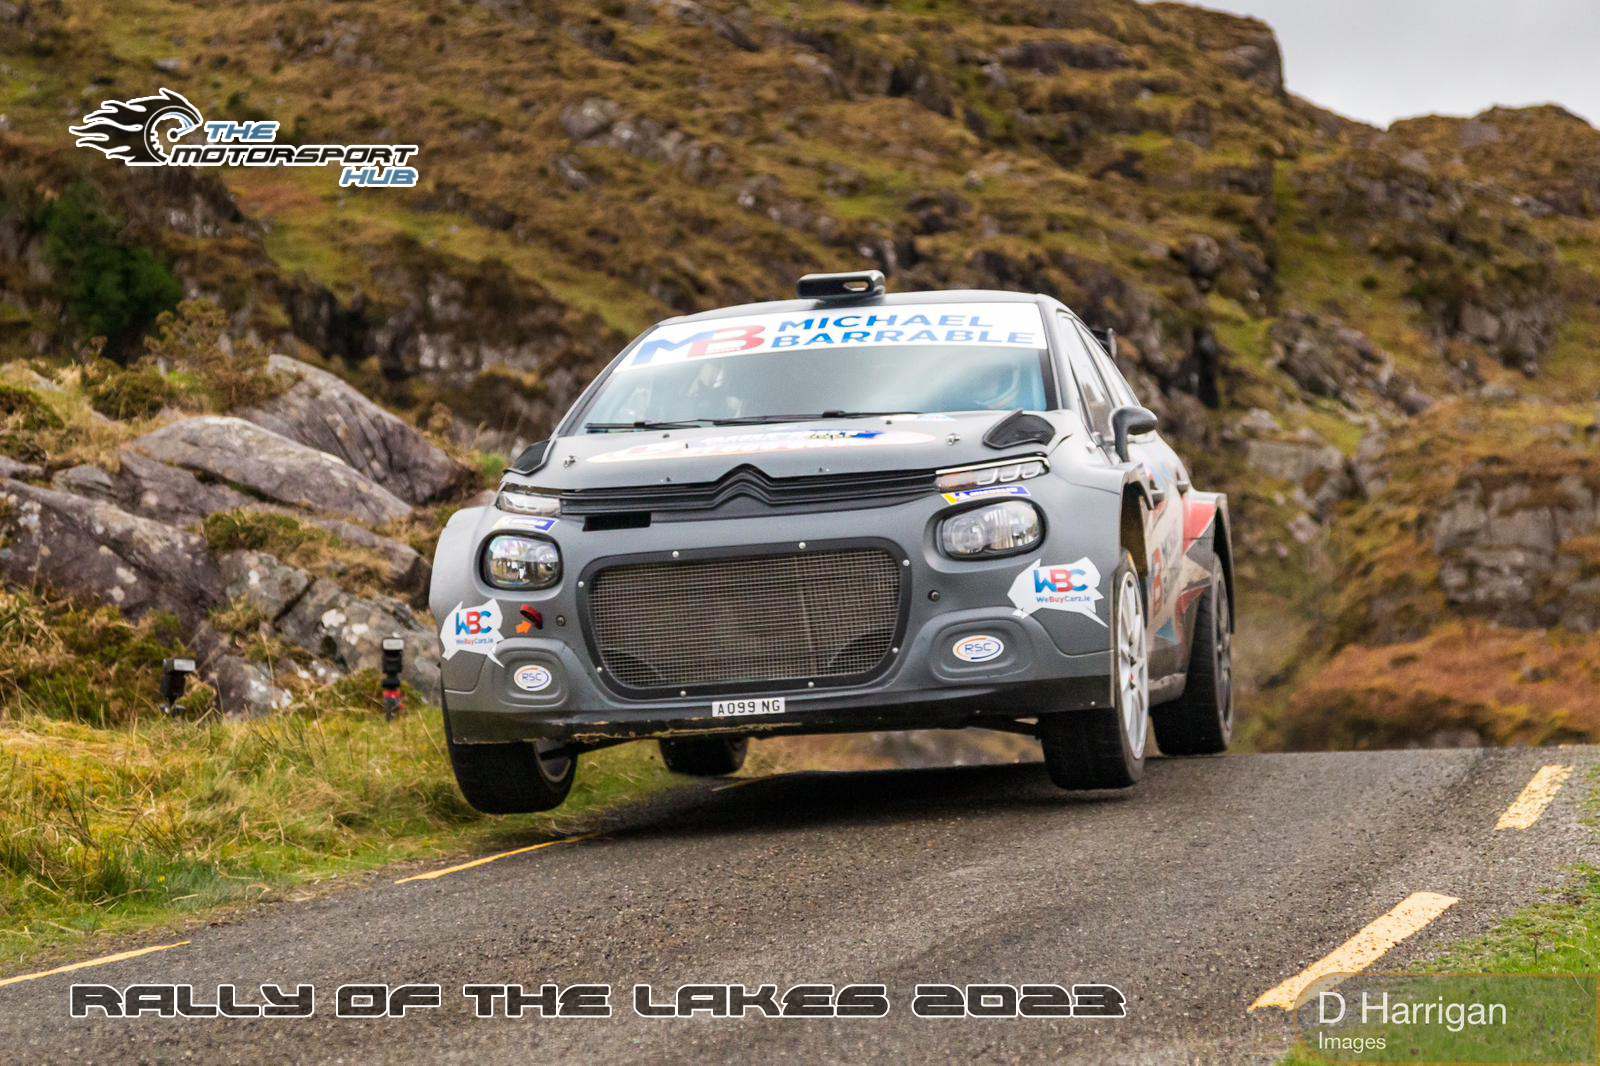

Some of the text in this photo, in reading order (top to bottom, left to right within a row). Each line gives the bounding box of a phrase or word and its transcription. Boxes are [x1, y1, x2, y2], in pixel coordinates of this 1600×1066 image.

[777, 314, 993, 332] MICHAEL
[770, 330, 1036, 348] BARRABLE
[1033, 569, 1088, 593] WBC
[456, 610, 492, 635] WBC
[965, 643, 993, 653] RSC
[522, 672, 542, 682] RSC
[761, 699, 780, 712] NG
